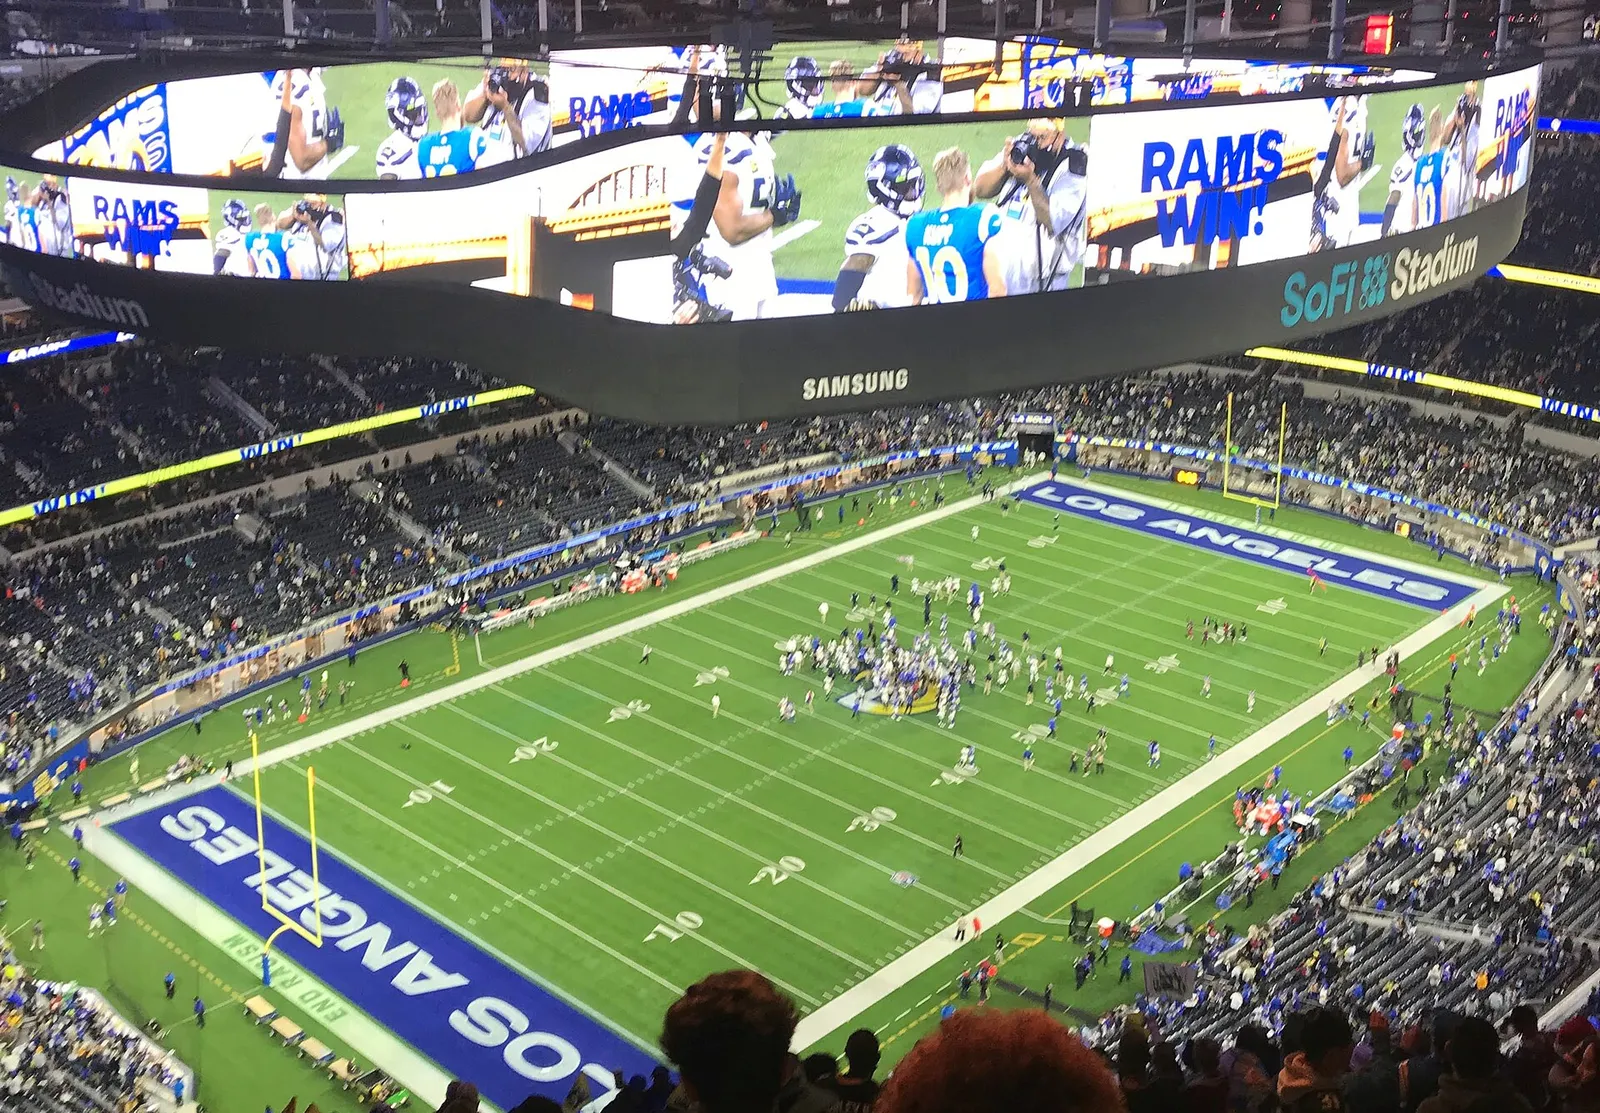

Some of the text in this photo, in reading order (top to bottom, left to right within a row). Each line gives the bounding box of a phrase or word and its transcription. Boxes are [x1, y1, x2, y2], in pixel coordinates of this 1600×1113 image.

[1141, 129, 1283, 193] RAMS
[93, 195, 179, 231] RAMS
[1156, 183, 1268, 248] WIN!
[916, 245, 969, 304] 10
[1281, 232, 1479, 328] SoFi Stadium
[803, 367, 908, 401] SAMSUNG
[240, 432, 304, 461] WIN!
[34, 485, 106, 516] WIN!
[1031, 486, 1146, 521] LOS
[1146, 518, 1450, 602] ANGELES
[851, 806, 898, 832] 30
[754, 856, 806, 885] 20
[160, 805, 471, 996] ANGELES
[648, 911, 704, 942] 10
